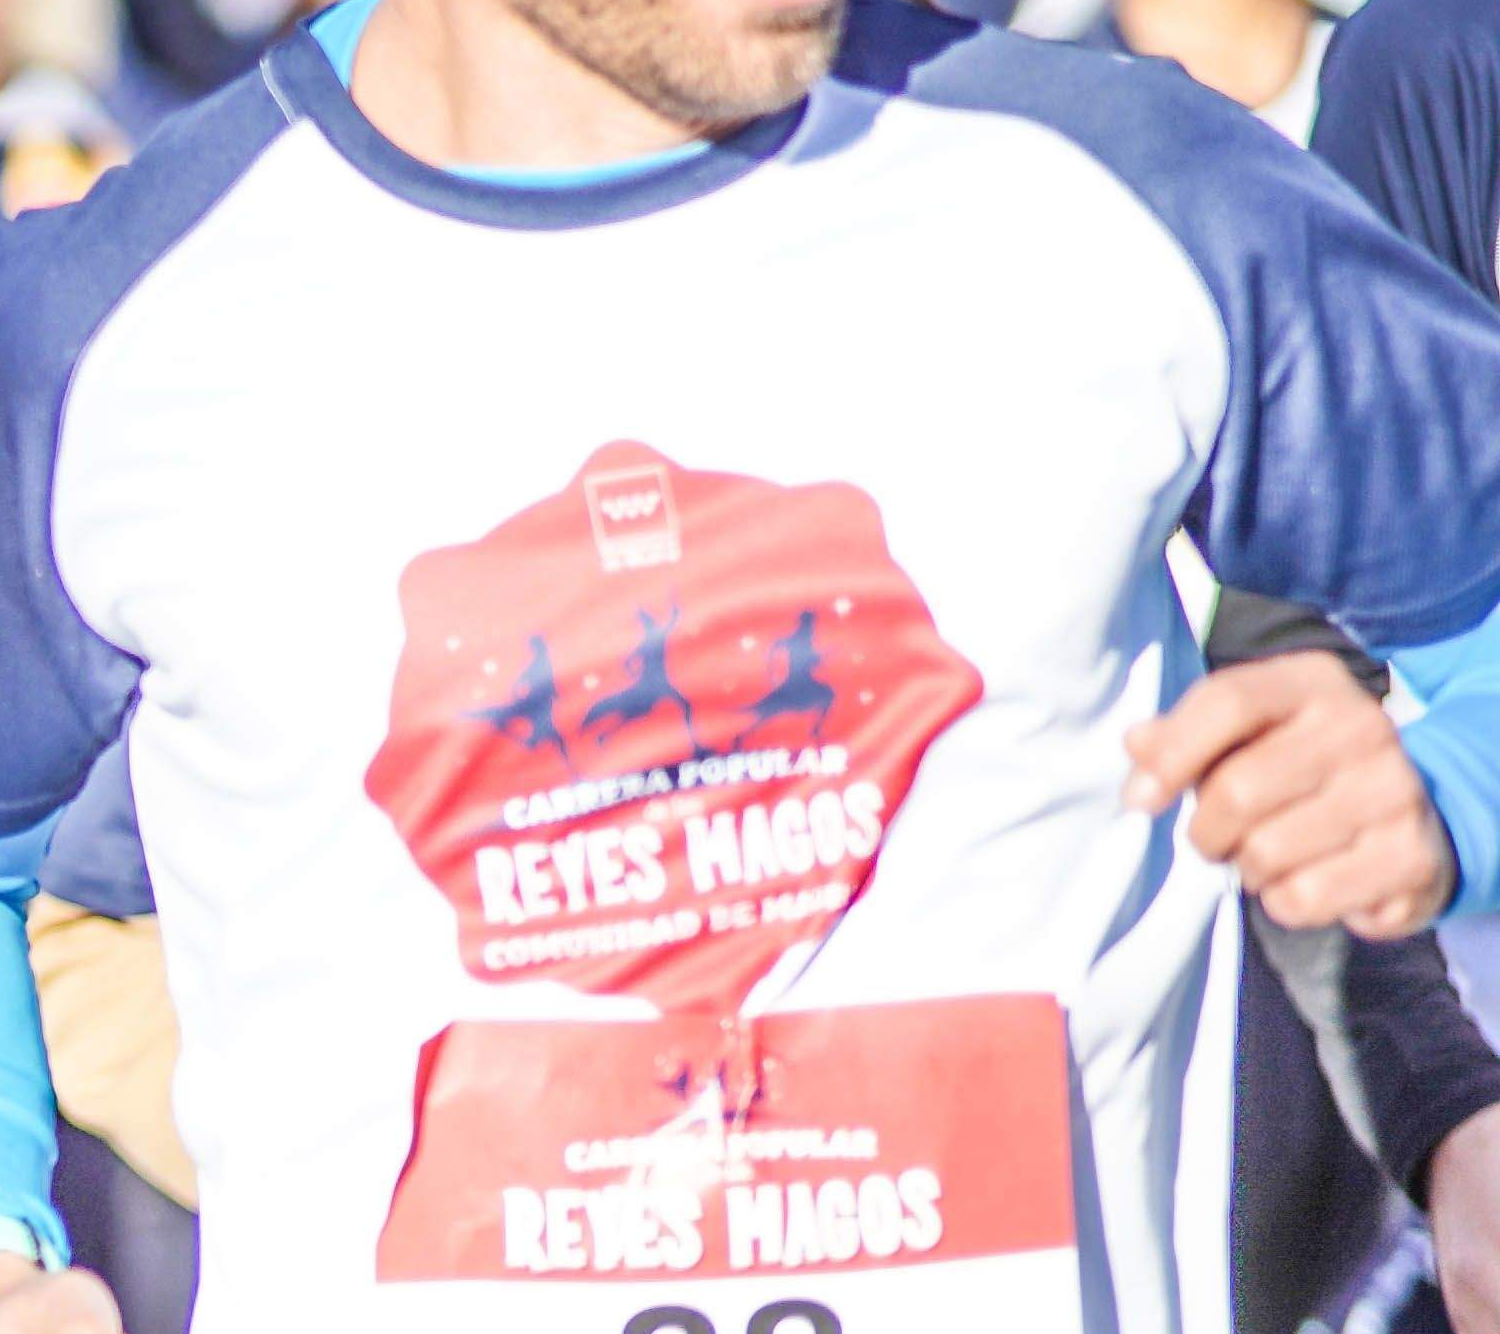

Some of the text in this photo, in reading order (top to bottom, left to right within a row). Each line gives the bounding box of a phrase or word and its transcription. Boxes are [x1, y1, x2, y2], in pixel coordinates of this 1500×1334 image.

[475, 780, 885, 926] REYES MAGOS
[502, 1167, 943, 1273] REYES MAGOS
